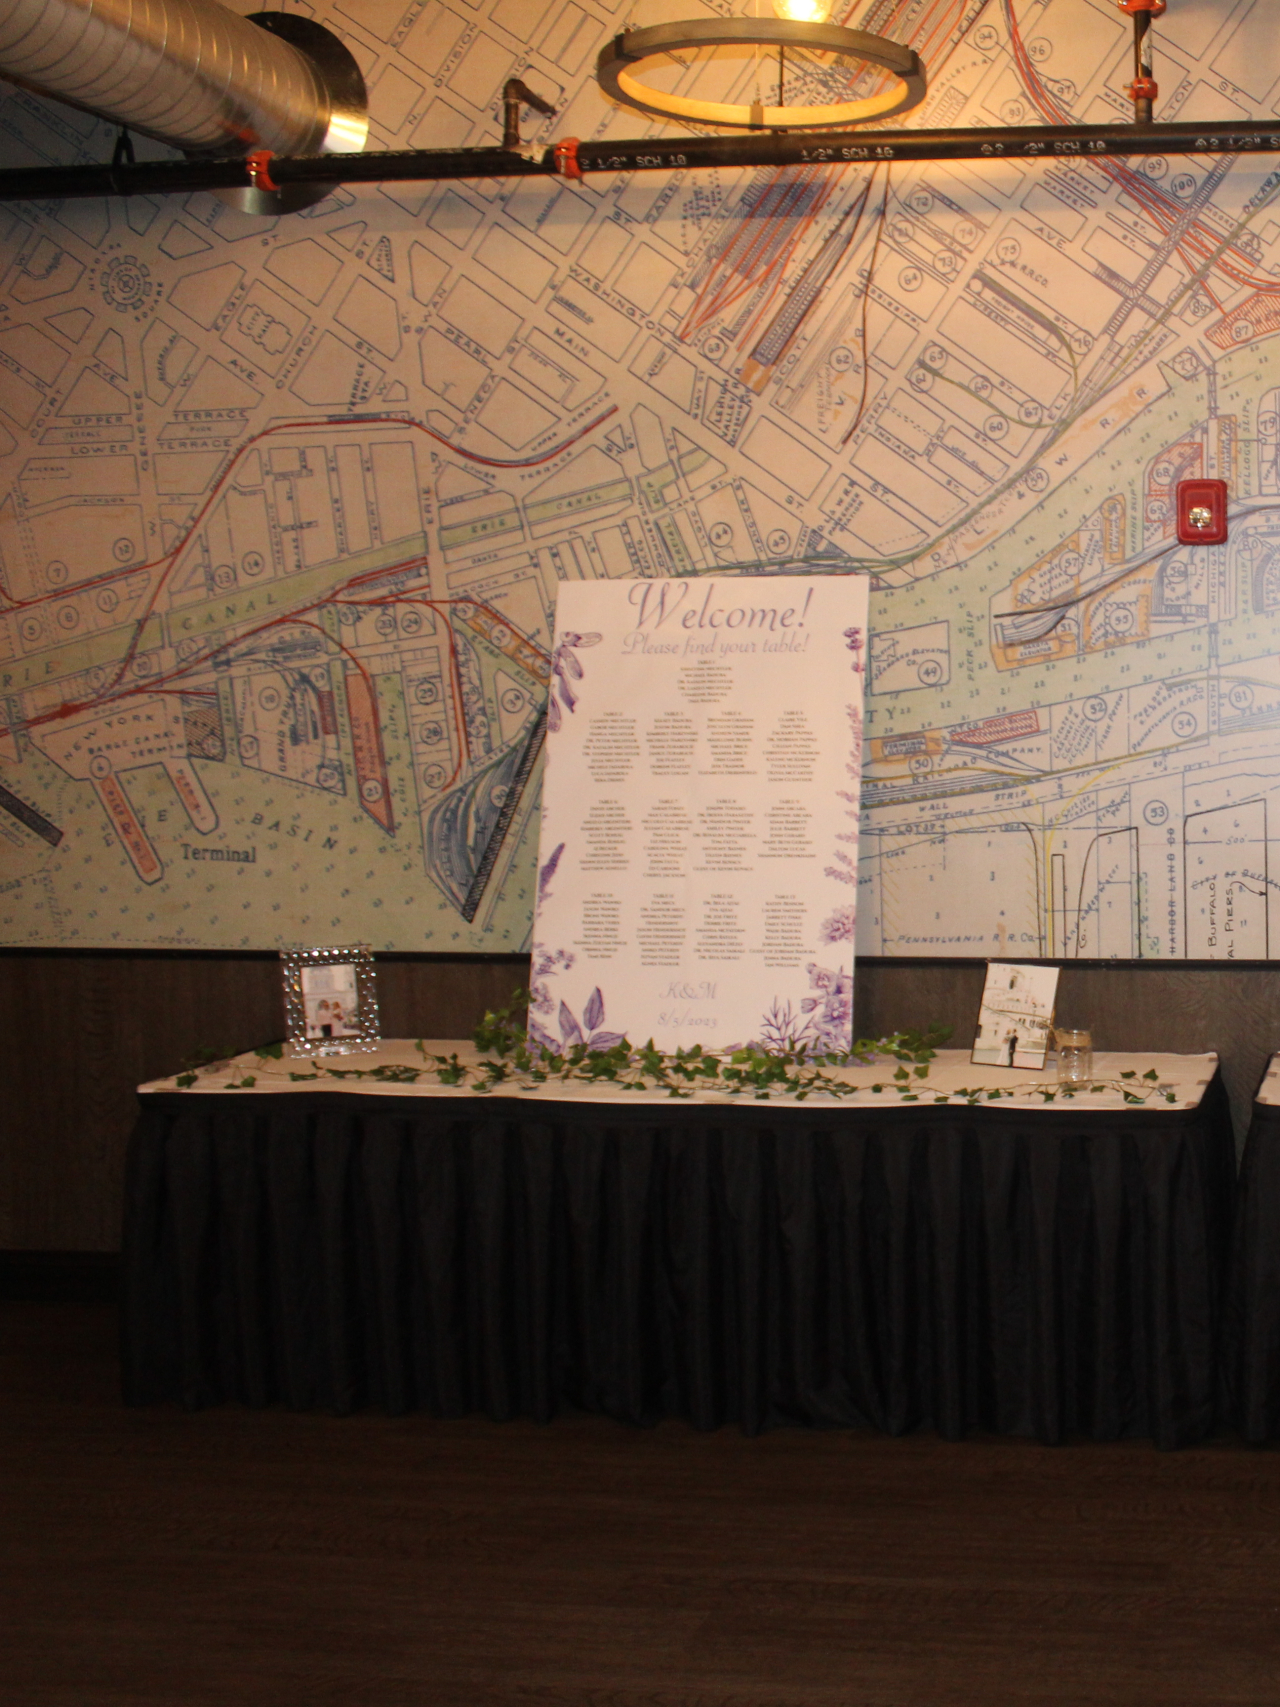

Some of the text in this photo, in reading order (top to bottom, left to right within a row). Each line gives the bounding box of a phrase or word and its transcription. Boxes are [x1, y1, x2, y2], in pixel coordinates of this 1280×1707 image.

[979, 30, 994, 44] 94
[433, 22, 478, 88] DIVISION
[1030, 43, 1045, 56] 96
[1057, 85, 1072, 96] 97
[1148, 159, 1163, 174] 99
[1172, 179, 1193, 193] 100
[1034, 226, 1068, 250] AVE.
[903, 273, 918, 285] 64
[214, 281, 248, 332] EAGLE
[569, 264, 665, 338] WASHINGTON
[1233, 325, 1250, 338] 87
[443, 327, 490, 365] PEARL
[553, 327, 590, 358] MAIN
[275, 324, 318, 390] CHURCH
[834, 354, 850, 365] 62
[1047, 392, 1071, 421] ELK
[72, 409, 248, 426] UPPER TERRACE
[852, 392, 888, 445] PERRY
[1259, 417, 1276, 432] 79
[71, 438, 233, 455] LOWER TERRACE
[470, 492, 602, 535] ERIE CANAL
[711, 525, 730, 542] 44
[1063, 557, 1079, 569] 57
[180, 593, 279, 632] CANAL
[627, 581, 815, 631] Welcome!
[1110, 613, 1128, 628] 55
[621, 631, 810, 658] Please find your table!
[922, 665, 939, 679] 49
[416, 687, 436, 700] 25
[1088, 701, 1106, 714] 52
[105, 713, 156, 735] YORK
[1175, 717, 1193, 730] 54
[918, 802, 949, 813] WALL
[1149, 806, 1166, 819] 53
[250, 812, 340, 851] BASIN
[181, 844, 257, 864] Terminal
[898, 934, 985, 945] PENNSYLVANIA
